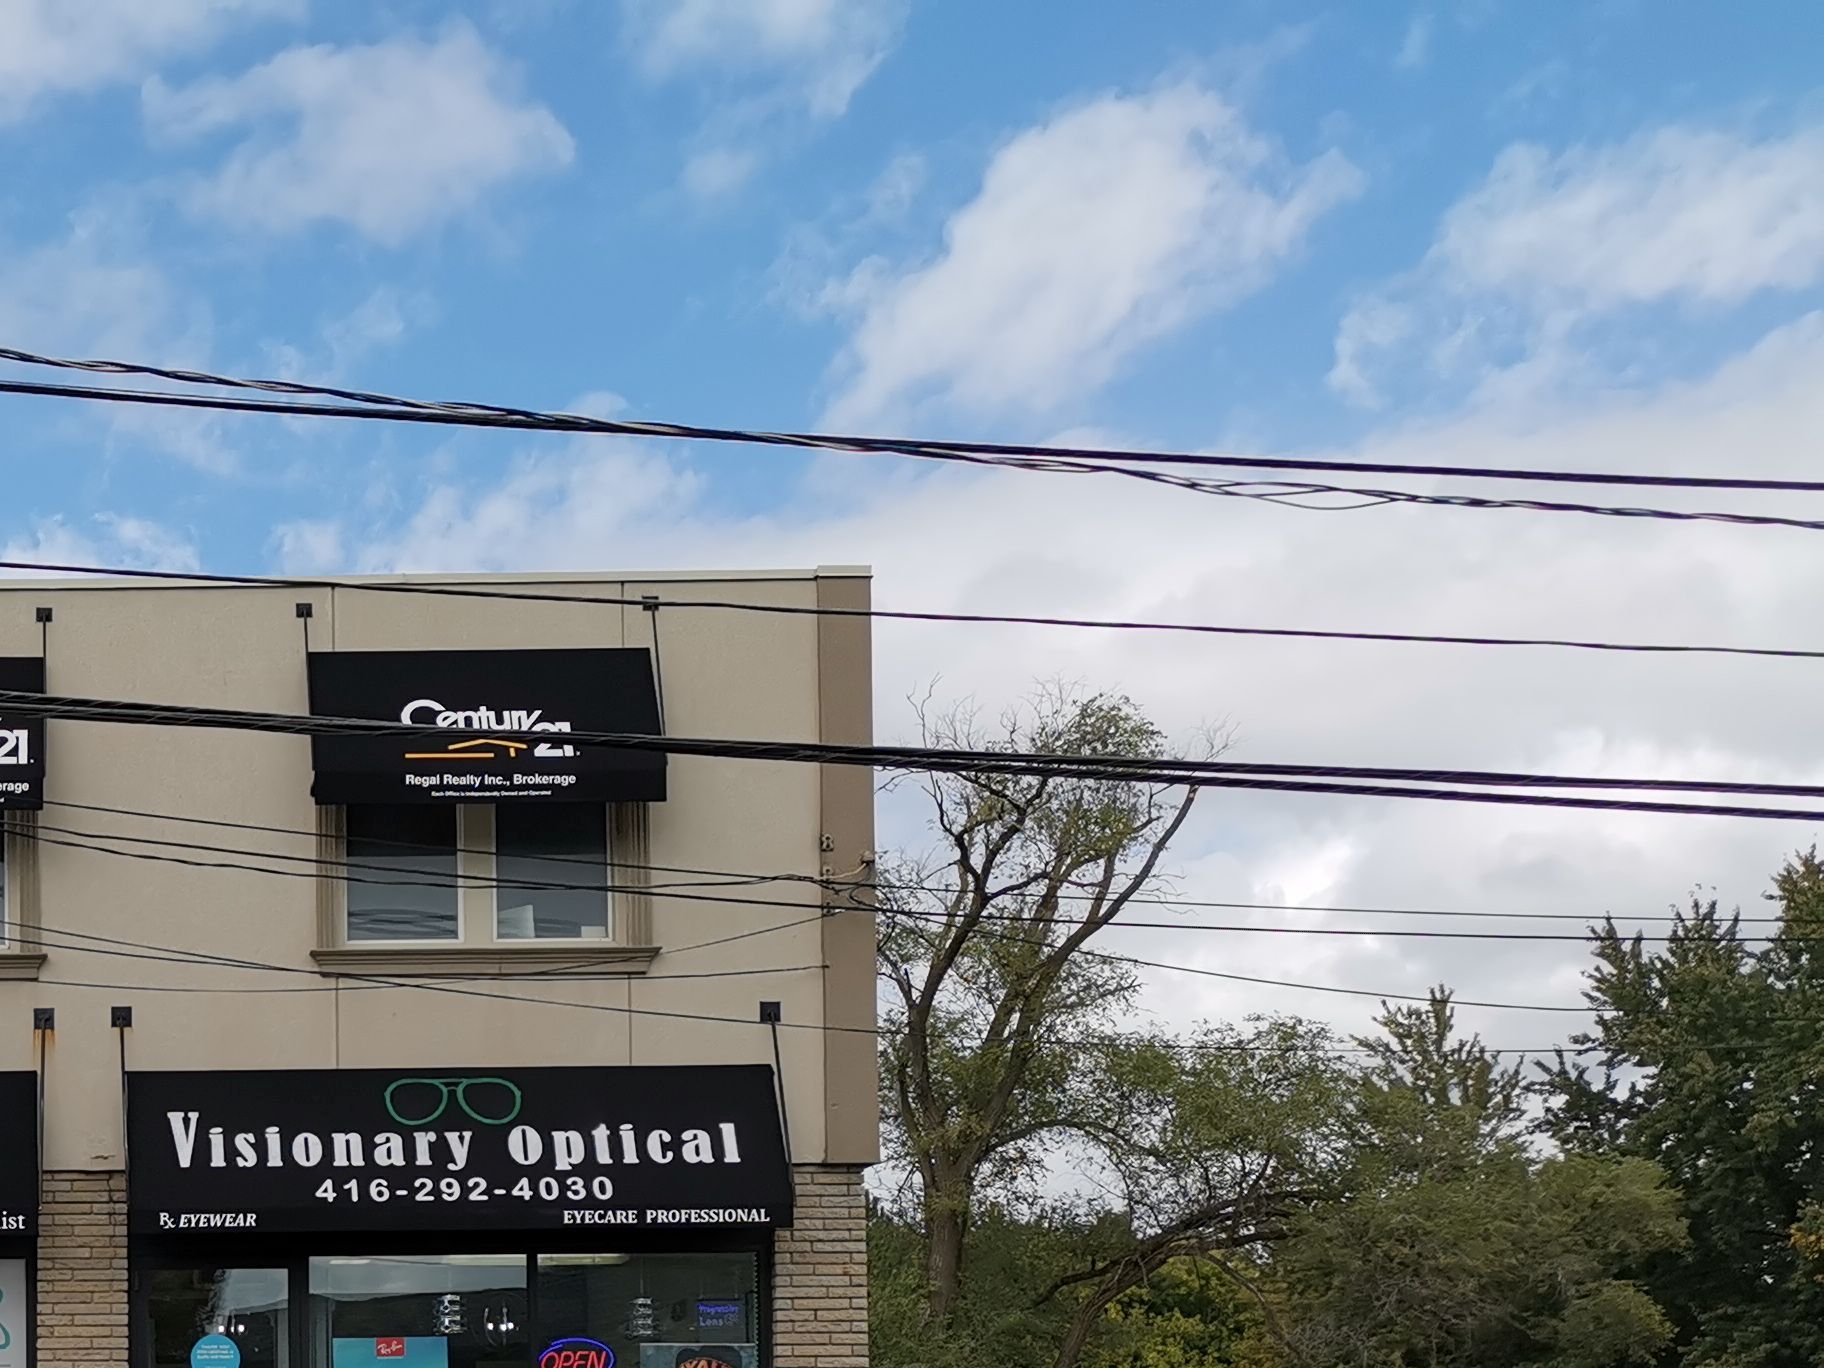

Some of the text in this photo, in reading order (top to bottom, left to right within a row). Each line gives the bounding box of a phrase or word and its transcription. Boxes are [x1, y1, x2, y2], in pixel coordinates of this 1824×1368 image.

[401, 699, 575, 757] Century 21
[405, 773, 576, 788] Regal Realty Inc., Brokerage
[167, 1111, 742, 1172] Visionary Optical
[315, 1175, 615, 1203] 416-292-4030
[179, 1213, 257, 1228] EYEWEAR
[563, 1208, 771, 1225] EYECARE PROFESSIONAL
